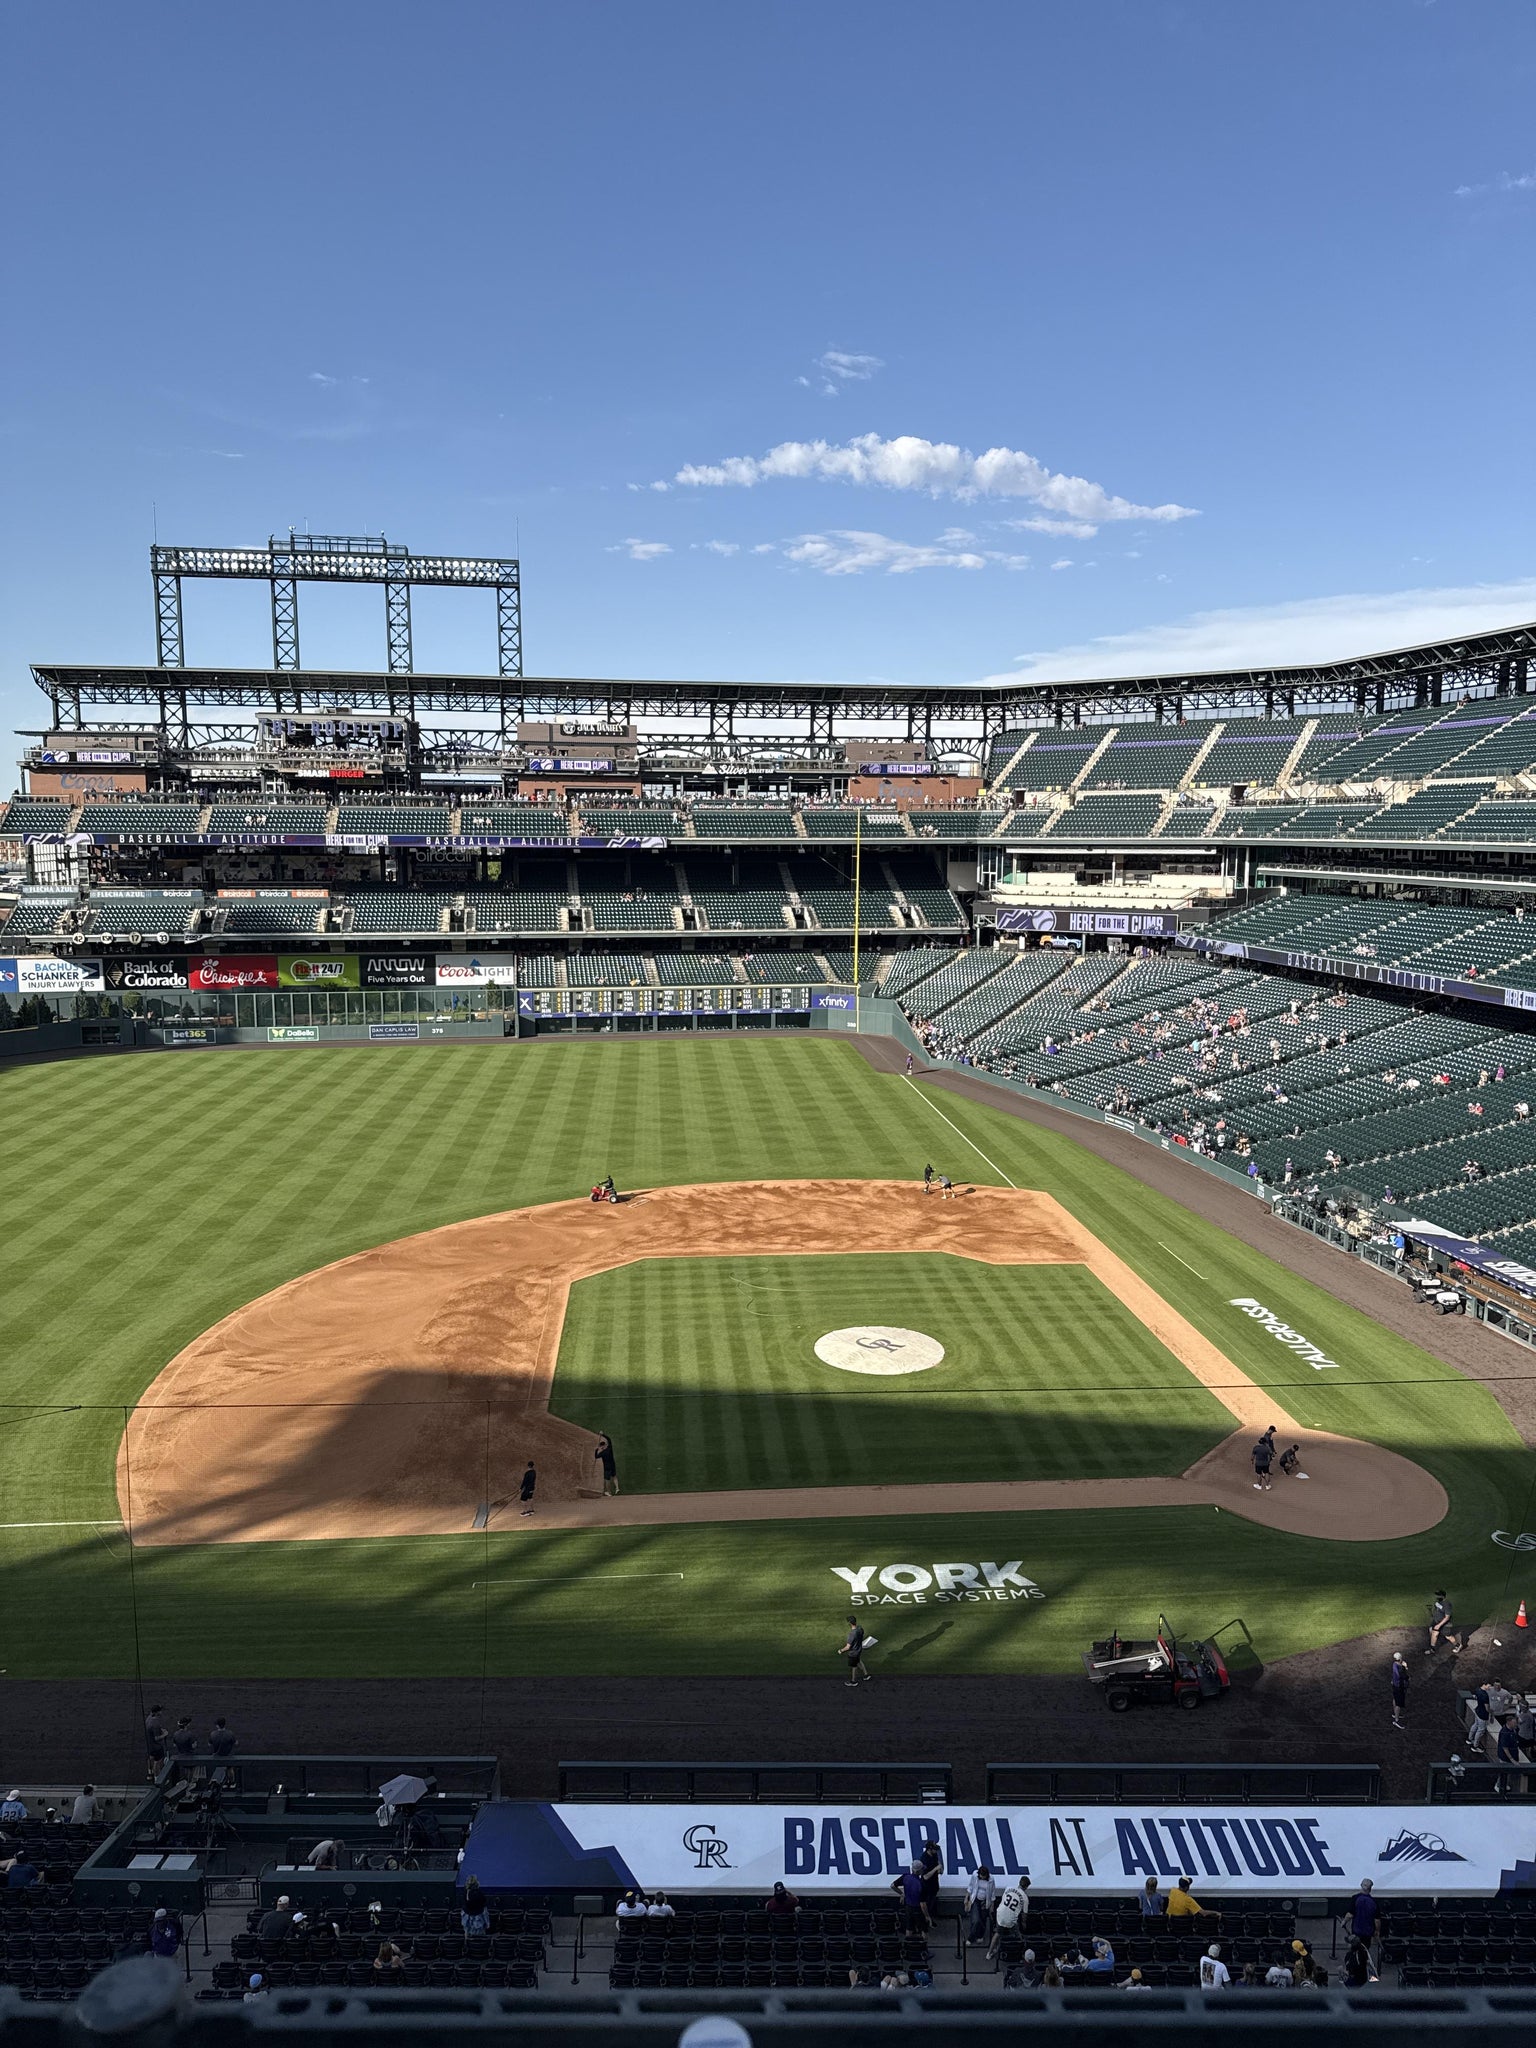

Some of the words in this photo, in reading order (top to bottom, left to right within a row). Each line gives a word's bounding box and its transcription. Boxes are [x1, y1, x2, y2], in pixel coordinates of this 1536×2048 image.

[259, 718, 297, 736] THE
[312, 720, 404, 738] ROOFTOP
[577, 724, 596, 732] JACK
[298, 770, 364, 778] SMASHBURGER
[718, 764, 748, 775] Silver
[60, 773, 116, 789] Coors
[120, 835, 188, 843] BASEBALL
[198, 835, 211, 843] AT
[222, 835, 285, 844] ALTITUDE
[426, 837, 490, 846] BASEBALL
[500, 837, 511, 846] AT
[522, 837, 580, 846] ALTITUDE
[1070, 913, 1095, 931] HERE
[1099, 918, 1110, 928] FOR
[1113, 918, 1125, 929] THE
[1132, 915, 1163, 932] CLIMB
[131, 934, 139, 942] 17
[159, 934, 168, 942] 33
[35, 963, 78, 971] BACHUS
[124, 961, 158, 973] Bank
[160, 960, 174, 973] of
[321, 964, 343, 974] 24/7
[439, 964, 476, 978] Coors
[477, 968, 511, 976] LIGHT
[22, 972, 79, 981] SCHANKER
[1287, 954, 1346, 976] BASEBALL
[1355, 964, 1368, 978] AT
[1378, 968, 1445, 993] ALTITUDE
[124, 974, 187, 986] Colorado
[819, 996, 848, 1008] xfinity
[1504, 989, 1523, 1008] HERE
[173, 1030, 206, 1038] bet365
[1241, 1306, 1340, 1370] TALLGRASS
[829, 1561, 1038, 1593] YORK
[851, 1593, 927, 1606] SPACE
[935, 1588, 1046, 1602] SYSTEMS
[784, 1818, 1030, 1875] BASEBALL
[1049, 1818, 1095, 1876] AT
[1114, 1818, 1346, 1876] ALTITUDE
[1004, 1894, 1019, 1912] 32
